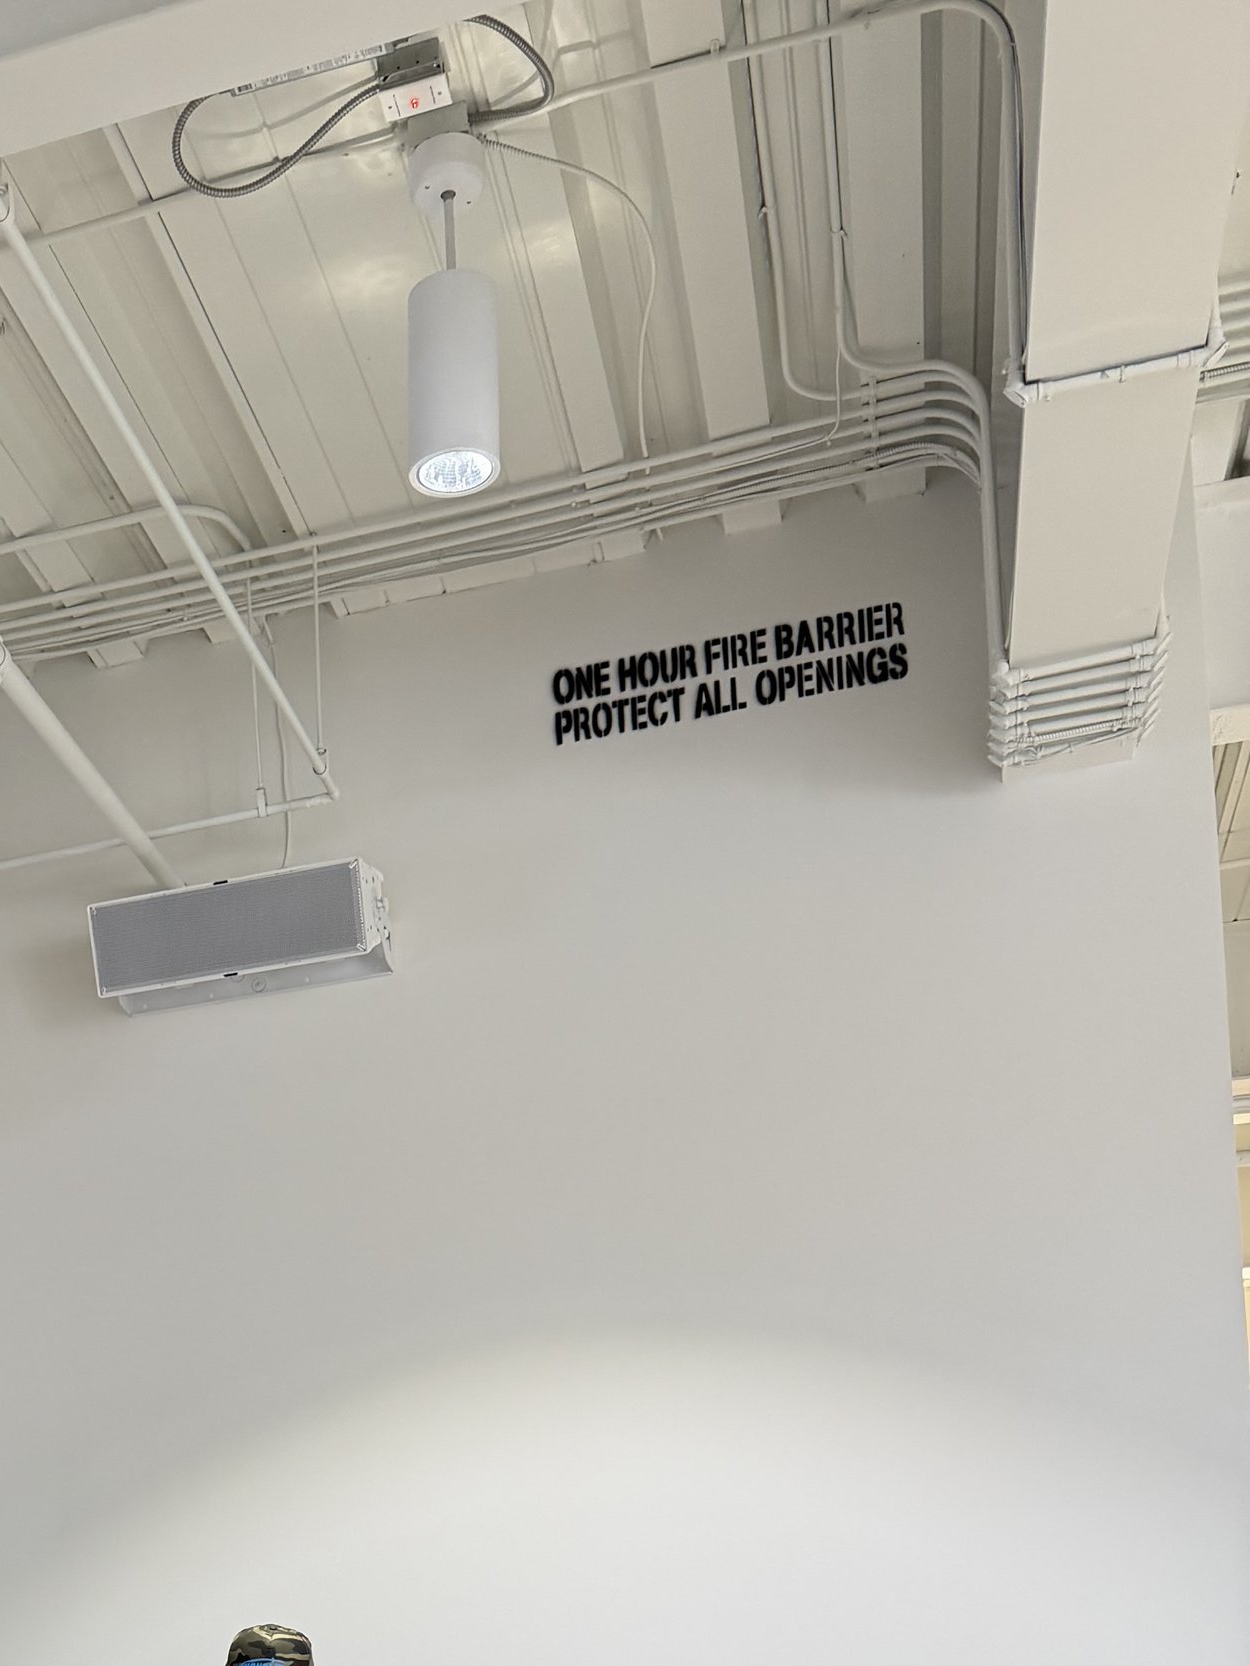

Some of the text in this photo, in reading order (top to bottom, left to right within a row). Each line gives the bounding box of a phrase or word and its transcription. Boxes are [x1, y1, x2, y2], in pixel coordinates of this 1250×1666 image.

[553, 602, 905, 705] ONE HOUR FIRE BARRIER
[554, 643, 909, 746] PROTECT ALL OPENINGS
